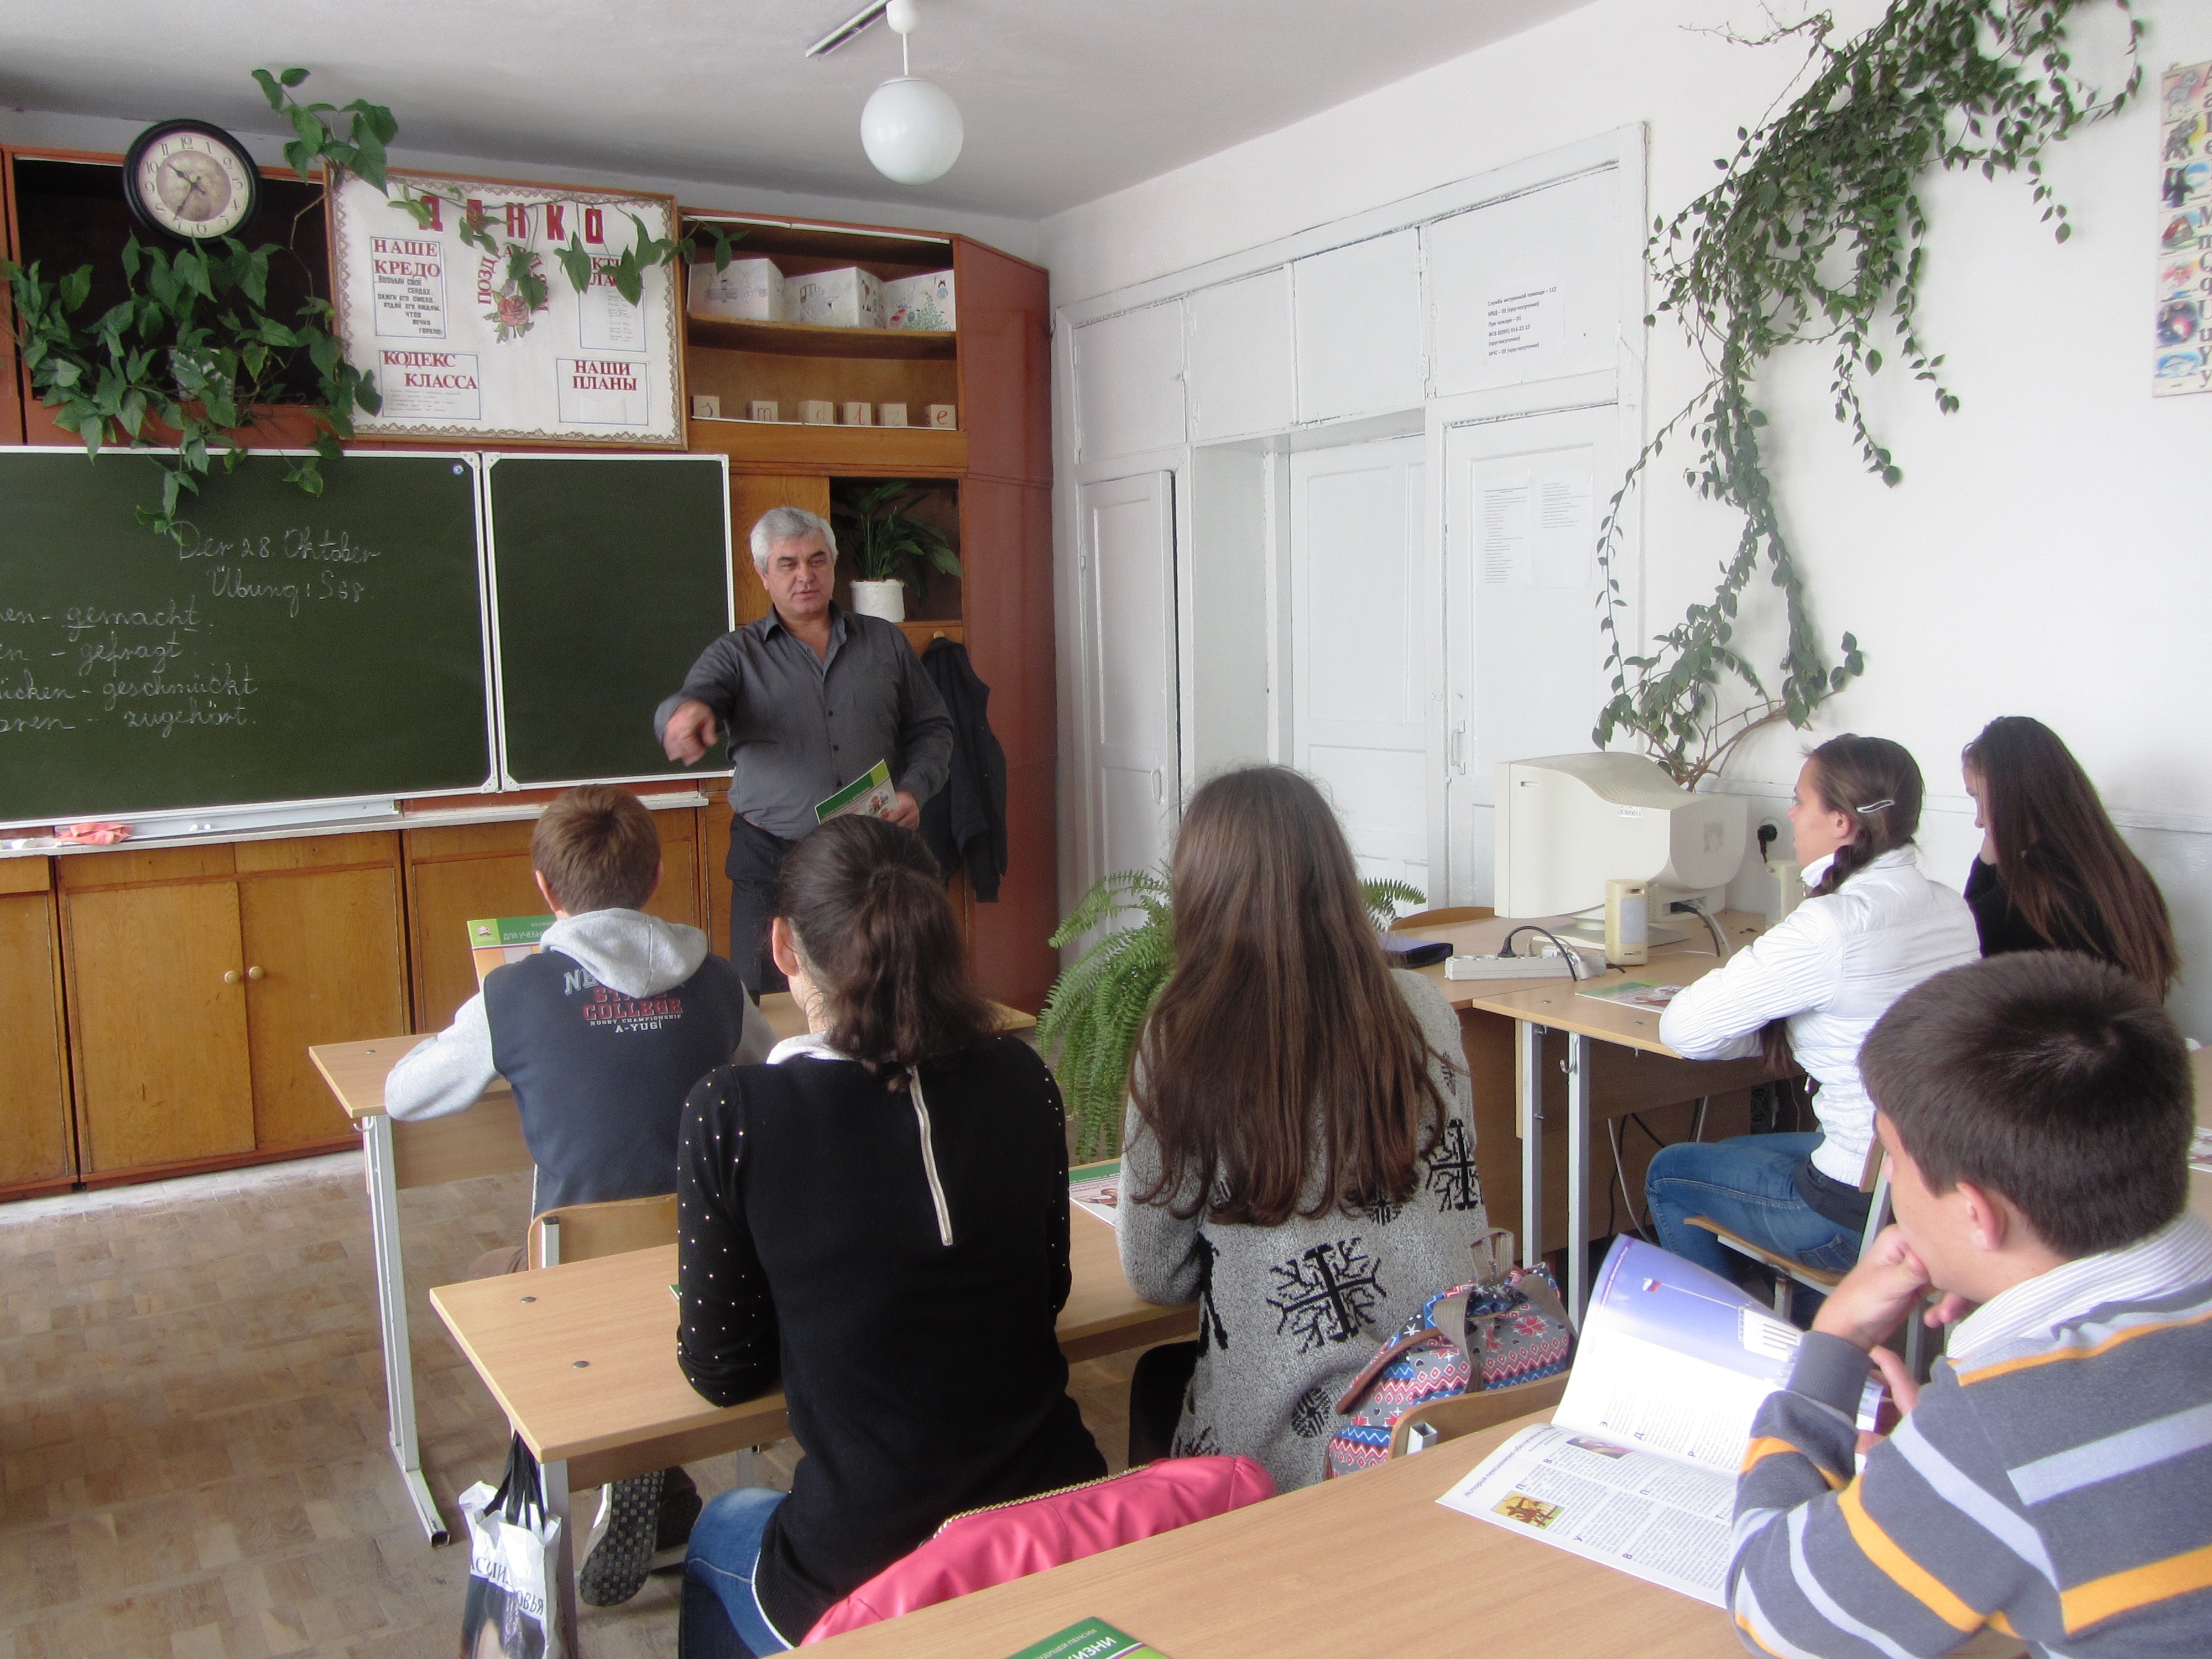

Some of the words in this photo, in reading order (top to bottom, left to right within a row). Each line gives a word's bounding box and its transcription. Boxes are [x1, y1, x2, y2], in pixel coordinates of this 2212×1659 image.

[373, 238, 437, 257] НАШЕ
[373, 259, 442, 280] КРЕДО
[383, 351, 456, 369] КОДЕКС
[575, 360, 632, 376] НАШИ
[404, 373, 478, 389] КЛАССА
[572, 375, 637, 391] ПЛАНЫ
[504, 932, 518, 941] ДЛЯ
[564, 968, 598, 995] NE
[582, 999, 684, 1020] COLLEGE
[622, 1014, 681, 1024] CHAMPIONSHIP
